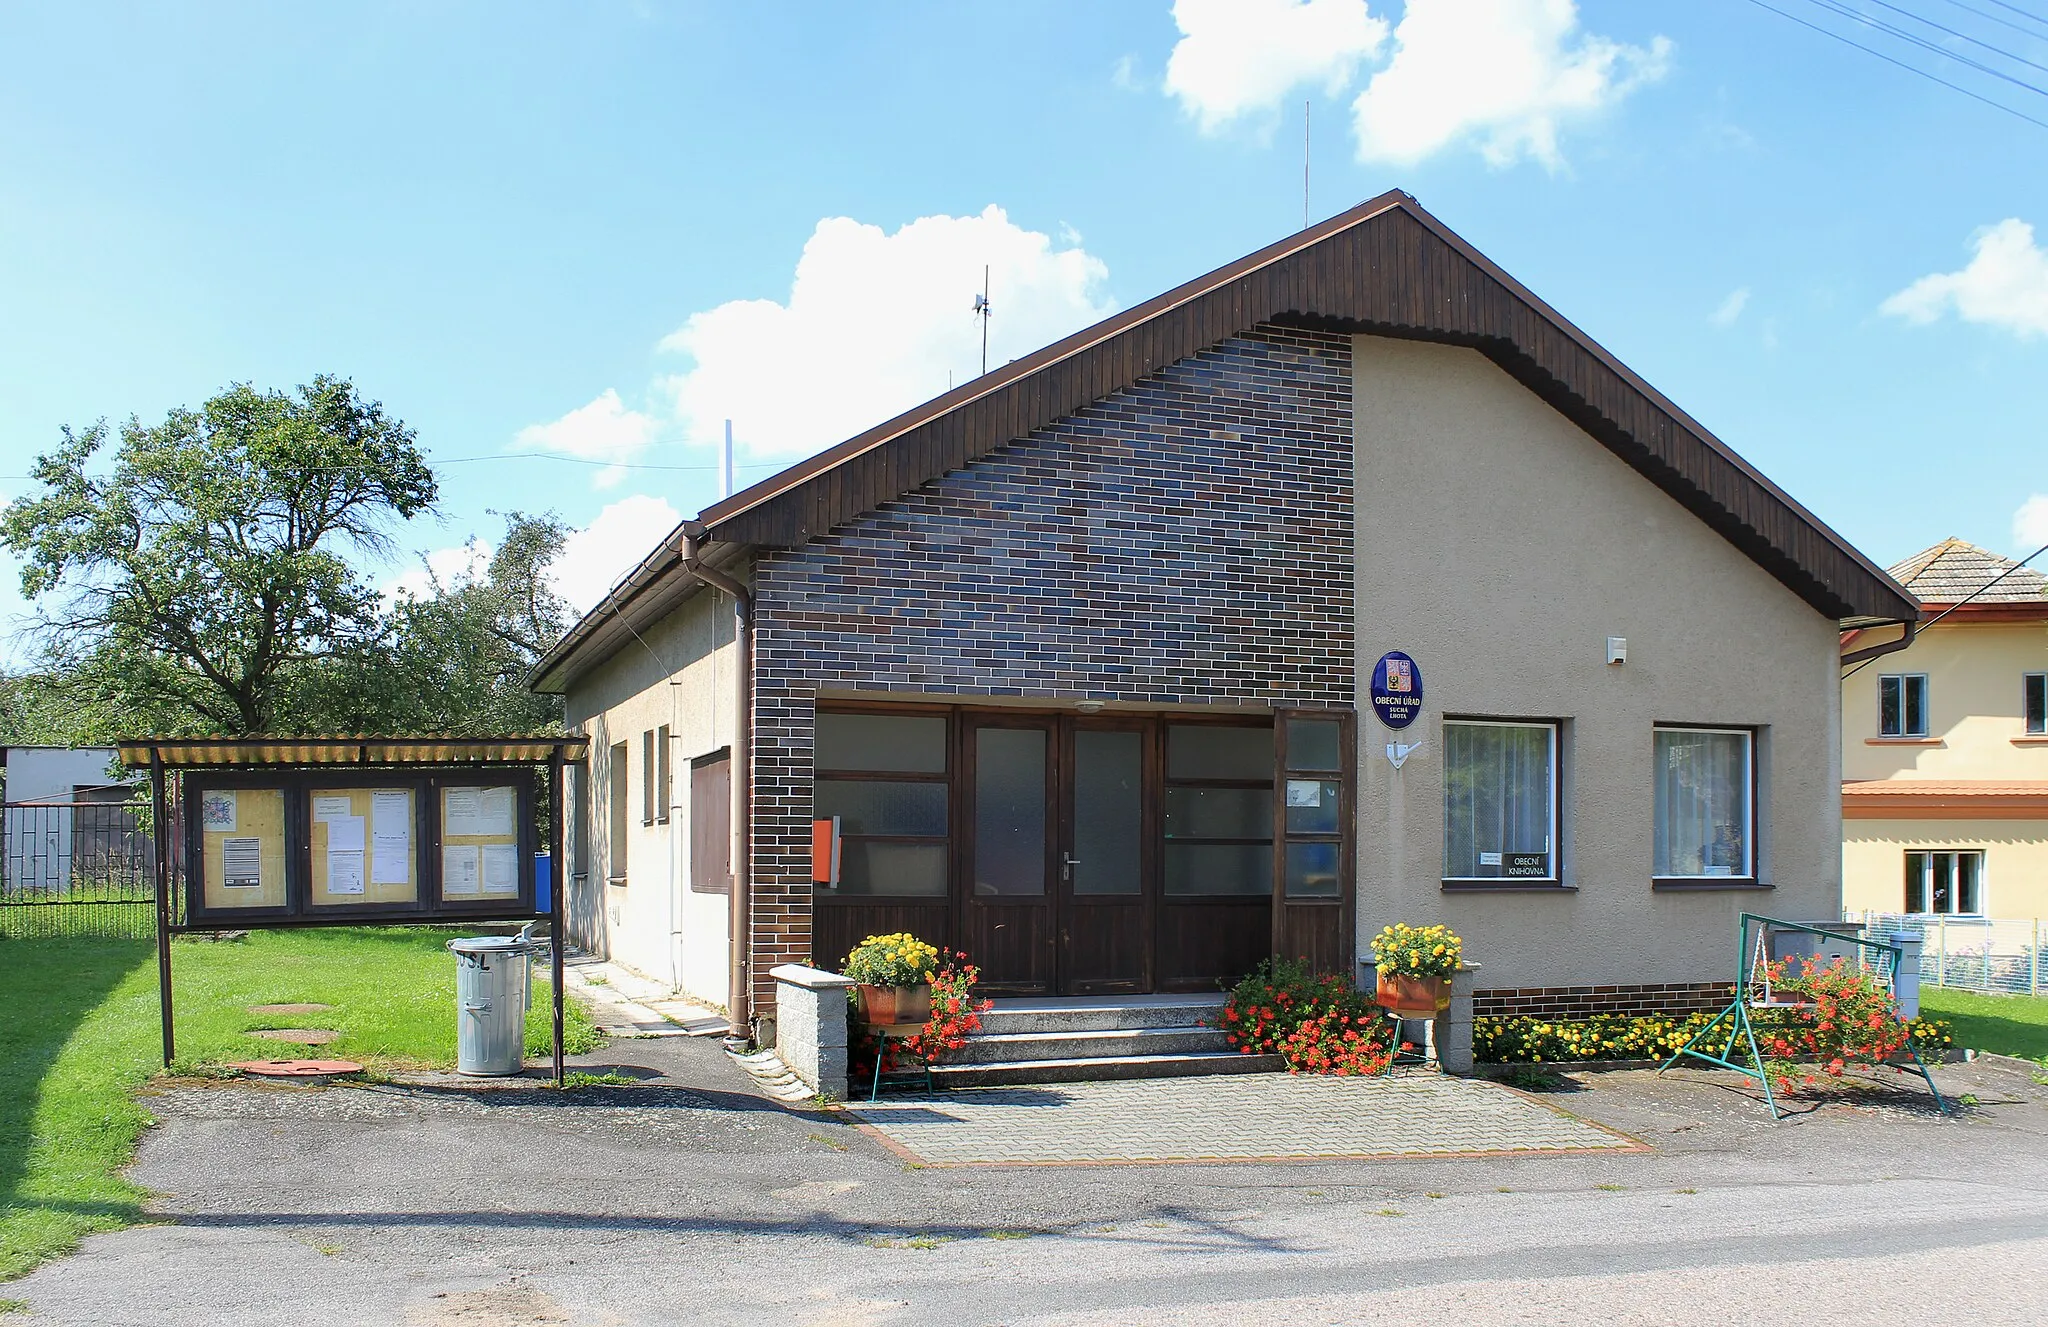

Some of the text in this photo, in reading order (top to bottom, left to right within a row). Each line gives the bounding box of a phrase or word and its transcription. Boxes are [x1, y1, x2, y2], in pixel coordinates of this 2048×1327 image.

[1375, 696, 1420, 706] OBECNÍ ÚŘAD
[1514, 856, 1540, 865] OBECNÍ
[1508, 867, 1544, 875] KNIHOVNA
